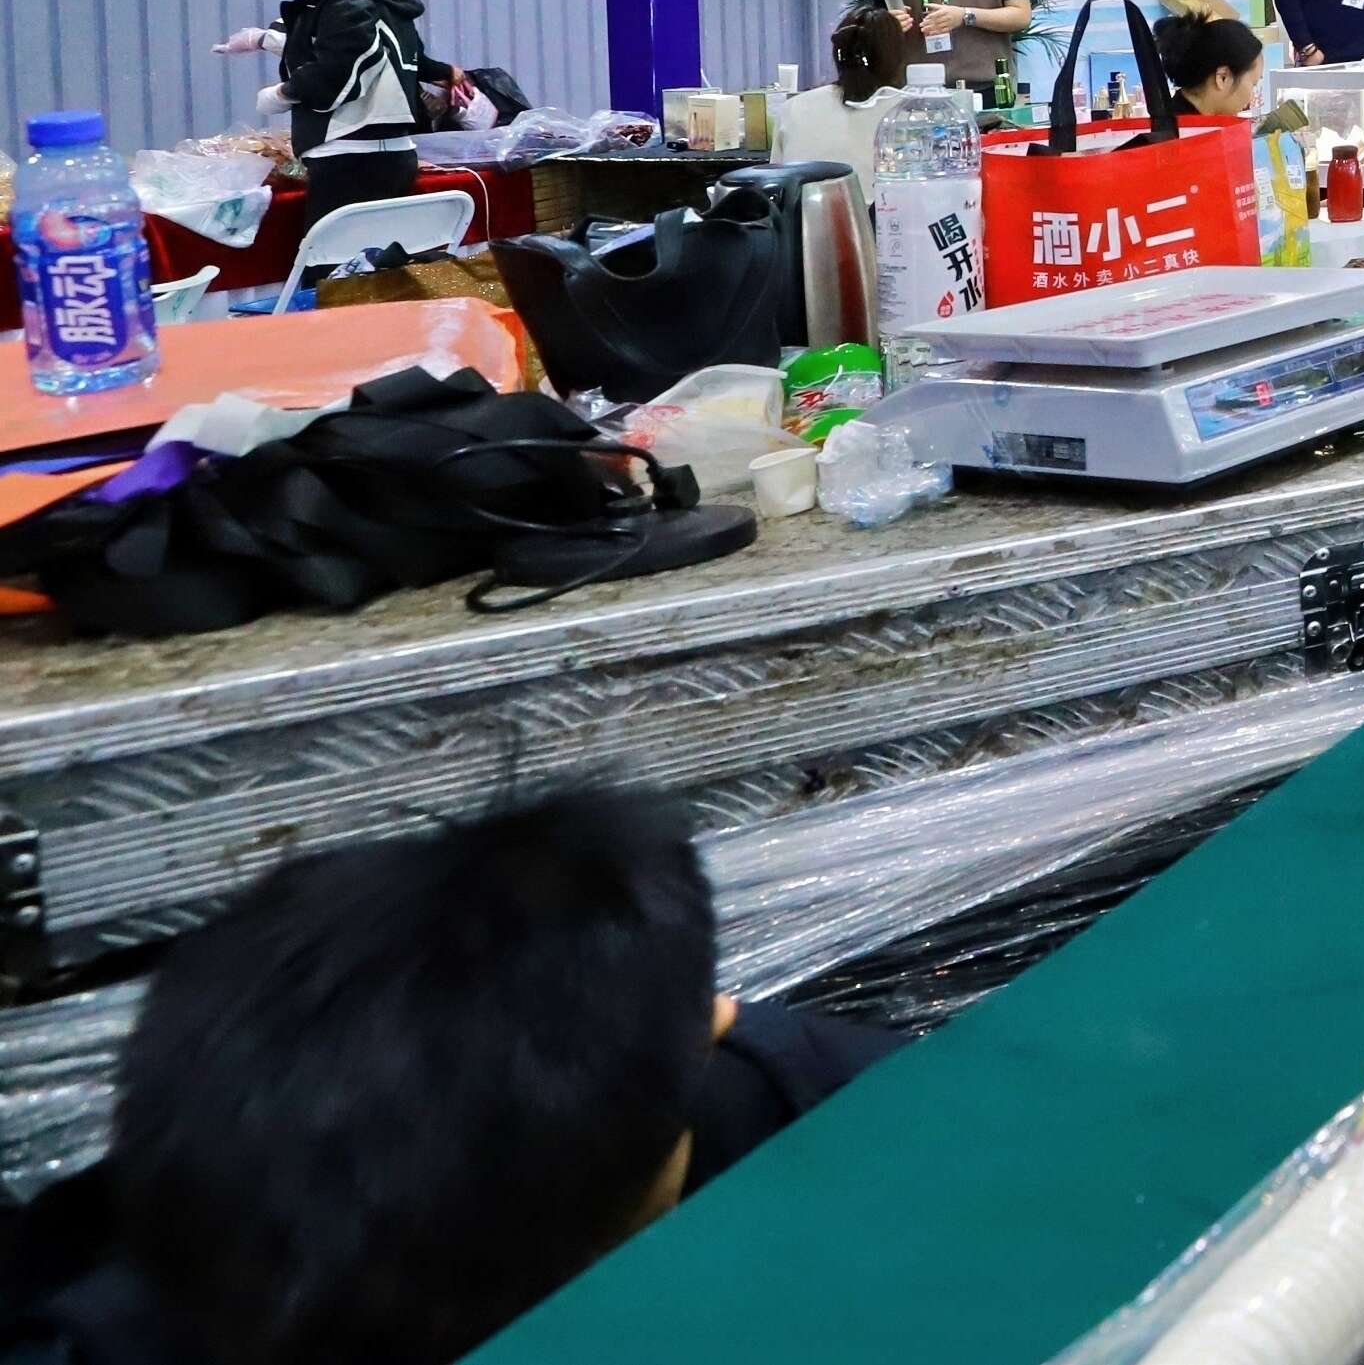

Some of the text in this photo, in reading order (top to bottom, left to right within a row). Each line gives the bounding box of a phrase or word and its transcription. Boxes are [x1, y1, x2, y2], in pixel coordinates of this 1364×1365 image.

[928, 213, 982, 312] 喝开水
[1032, 194, 1195, 266] 酒小二
[1032, 249, 1200, 289] 酒水外卖 小二真快
[47, 255, 117, 345] 脉动
